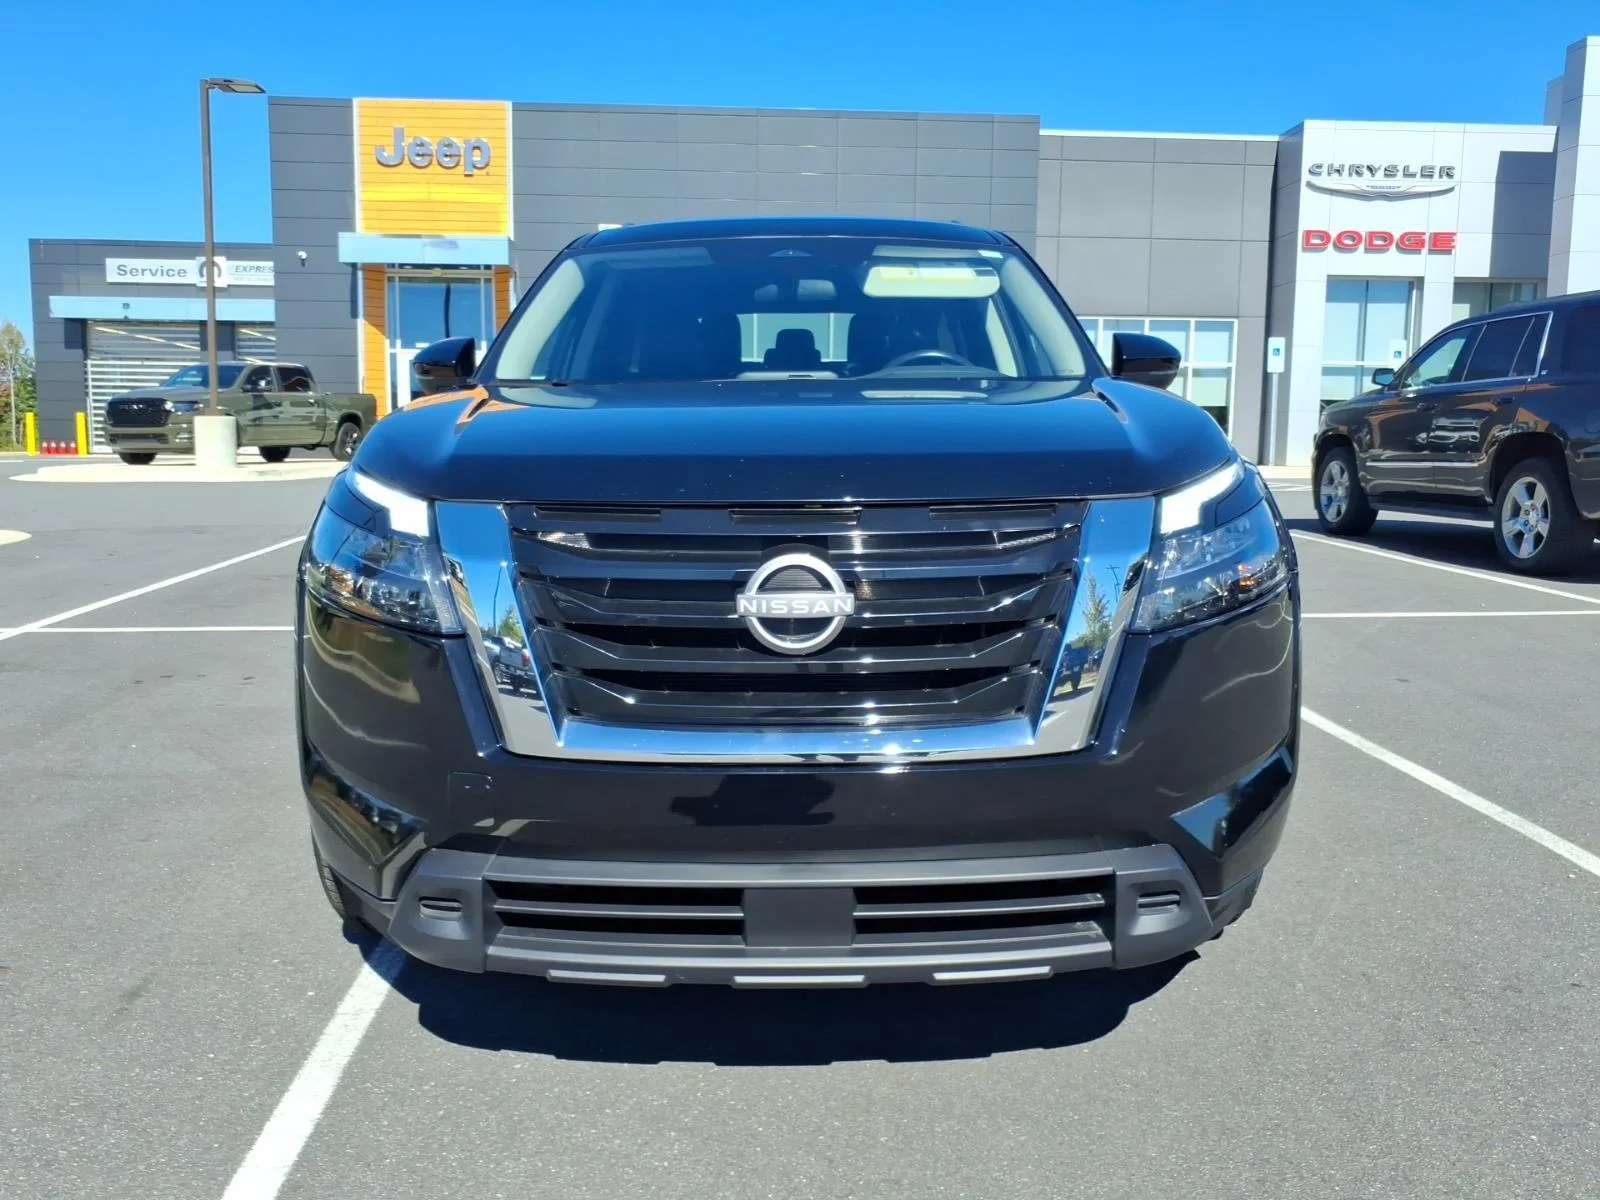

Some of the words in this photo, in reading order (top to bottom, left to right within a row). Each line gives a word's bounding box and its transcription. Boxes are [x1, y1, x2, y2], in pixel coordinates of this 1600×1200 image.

[375, 126, 492, 177] Jeep
[1308, 163, 1456, 179] CHRYSLER
[1302, 230, 1457, 251] DODGE
[117, 264, 188, 278] Service
[740, 599, 853, 614] NISSAN
